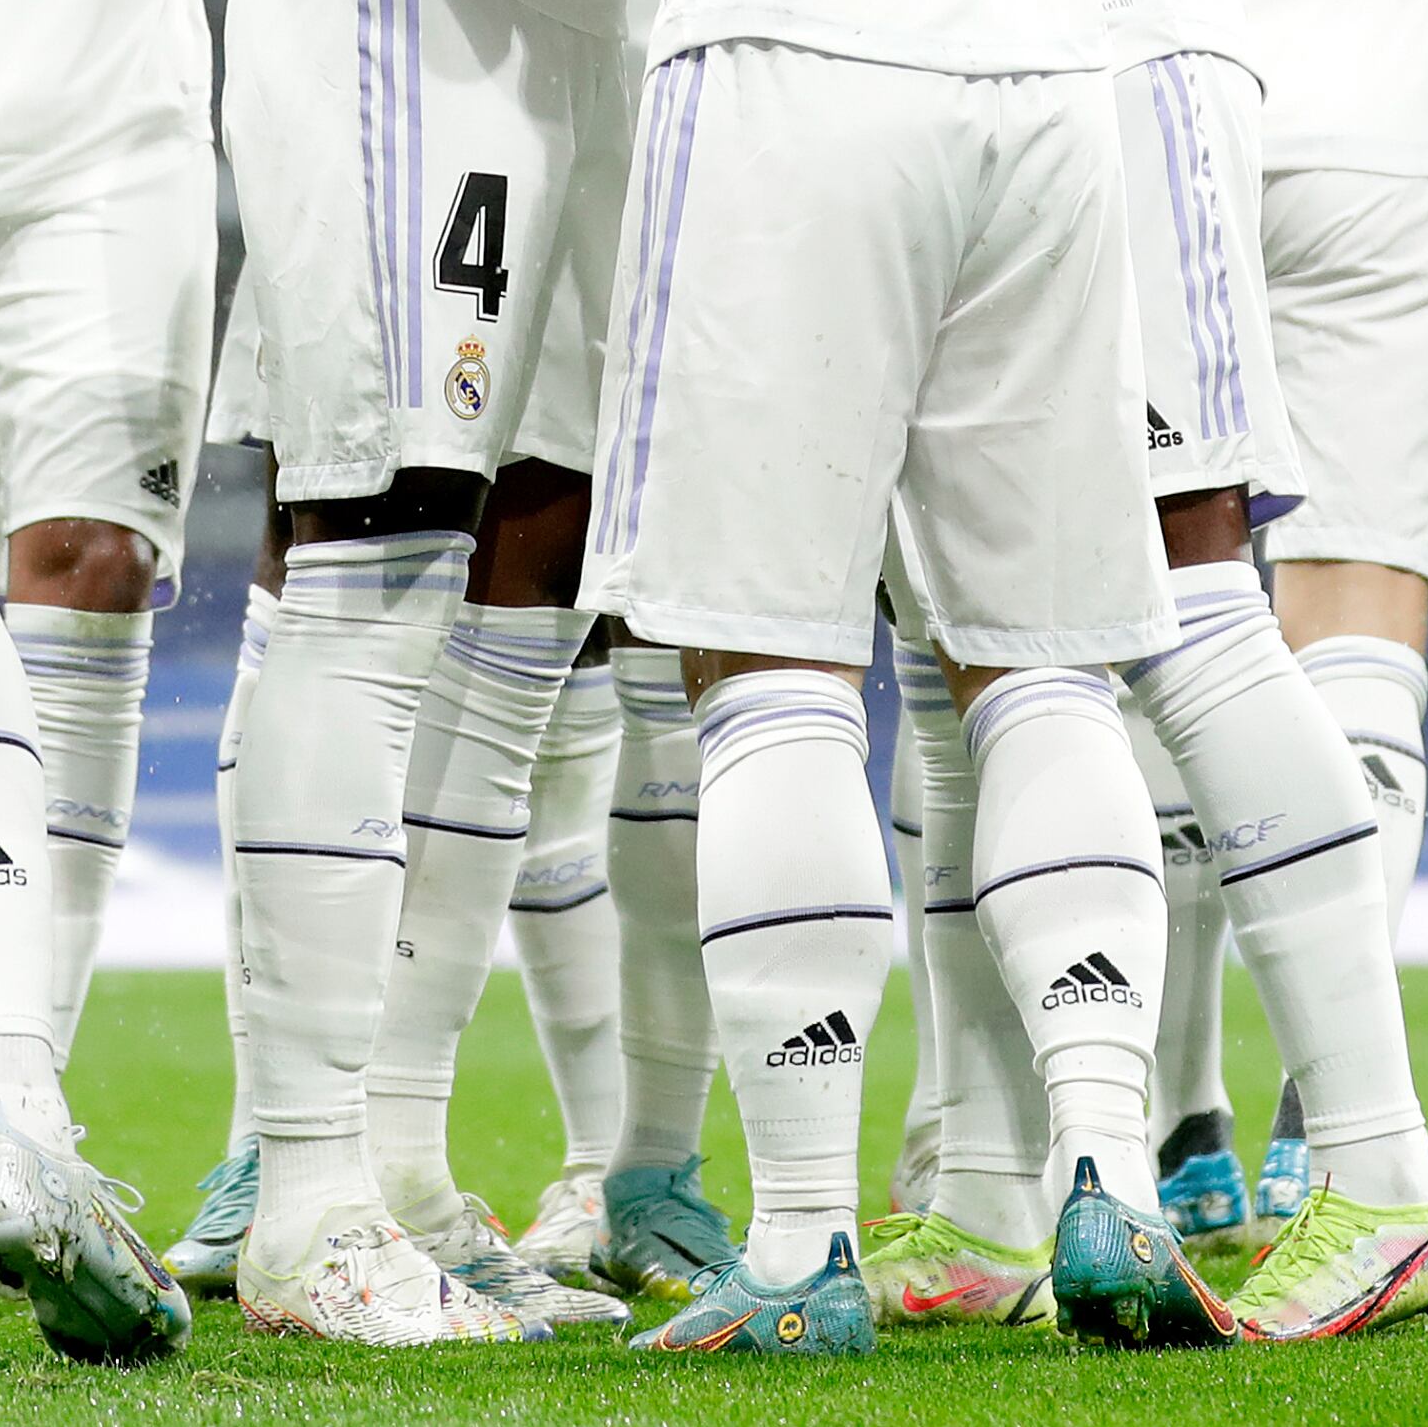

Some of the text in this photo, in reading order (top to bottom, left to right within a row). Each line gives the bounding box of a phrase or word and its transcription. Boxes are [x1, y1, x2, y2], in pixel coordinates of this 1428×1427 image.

[432, 171, 510, 324] 4
[1041, 981, 1143, 1010] adidas
[766, 1041, 863, 1067] adidas
